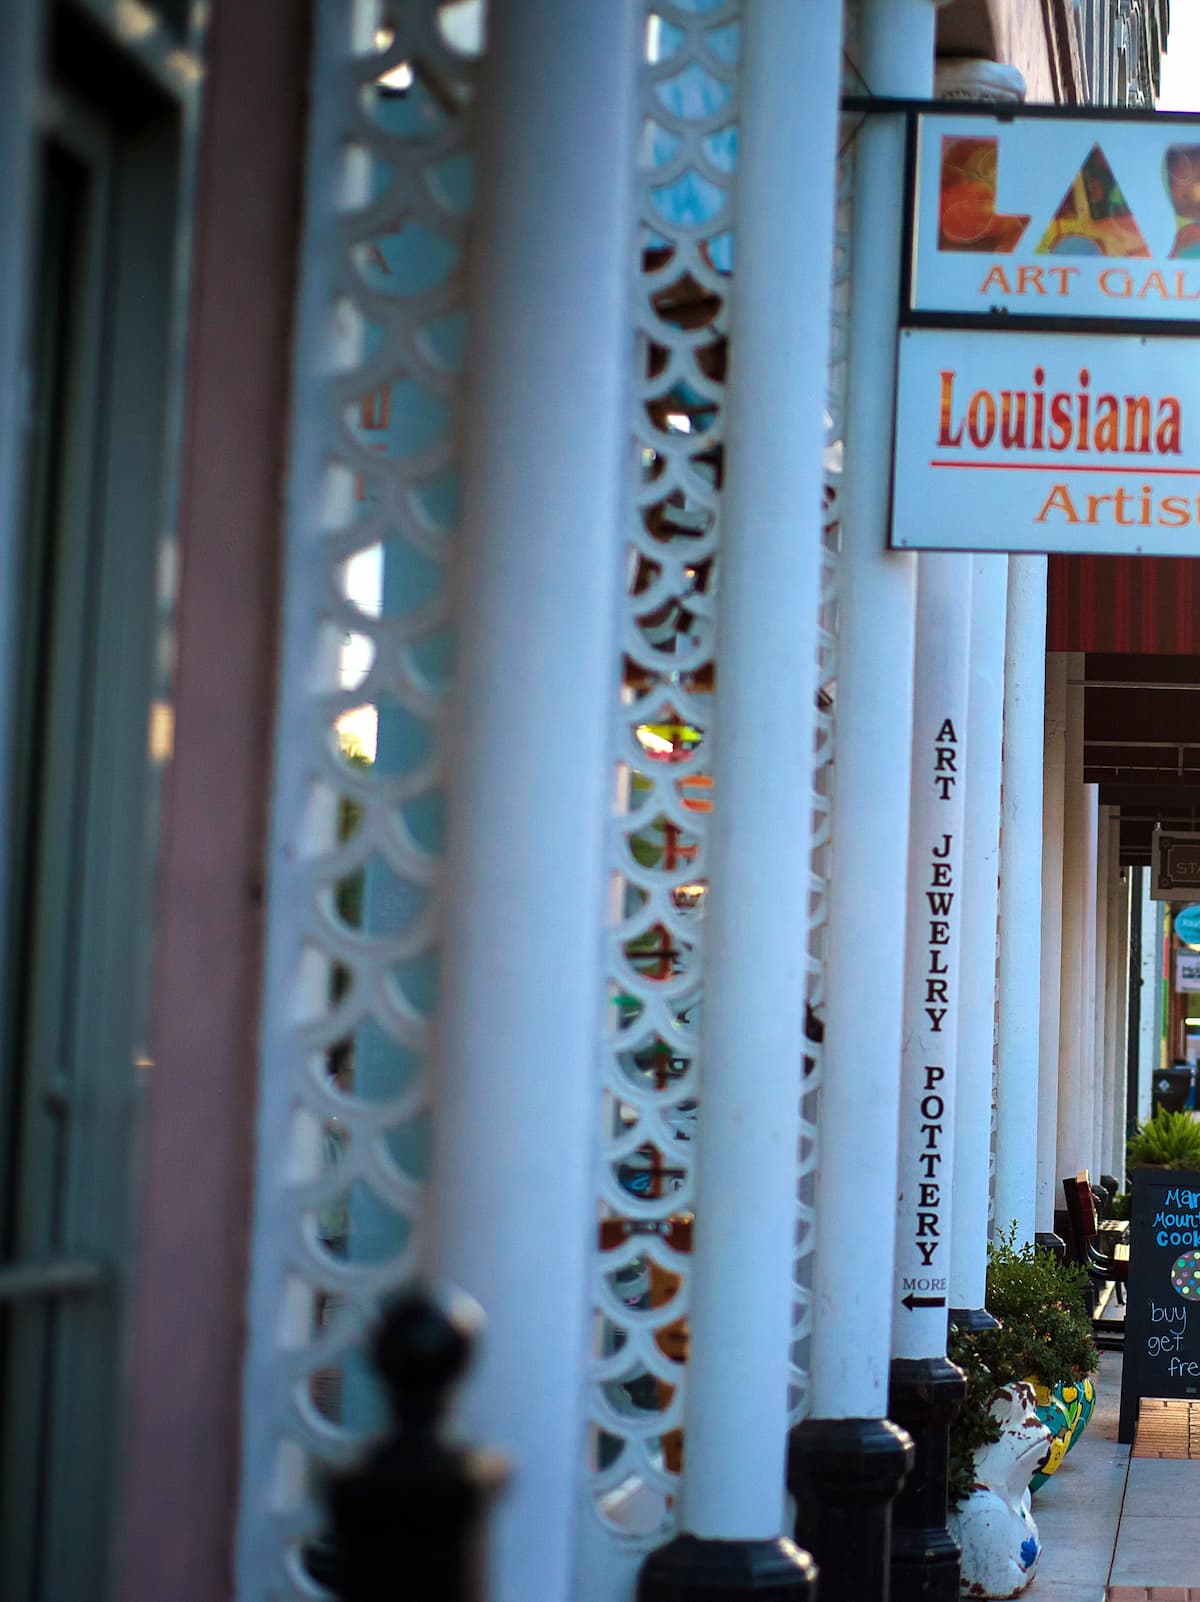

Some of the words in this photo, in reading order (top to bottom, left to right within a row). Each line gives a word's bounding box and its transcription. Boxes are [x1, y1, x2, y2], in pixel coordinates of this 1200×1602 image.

[978, 265, 1080, 297] ART
[936, 366, 1182, 456] Louisiana
[934, 719, 958, 800] ART
[924, 834, 954, 1032] JEWELRY
[915, 1066, 945, 1266] POTTERY
[902, 1277, 947, 1291] MORE
[1148, 1334, 1184, 1357] get
[1151, 1302, 1187, 1335] buy
